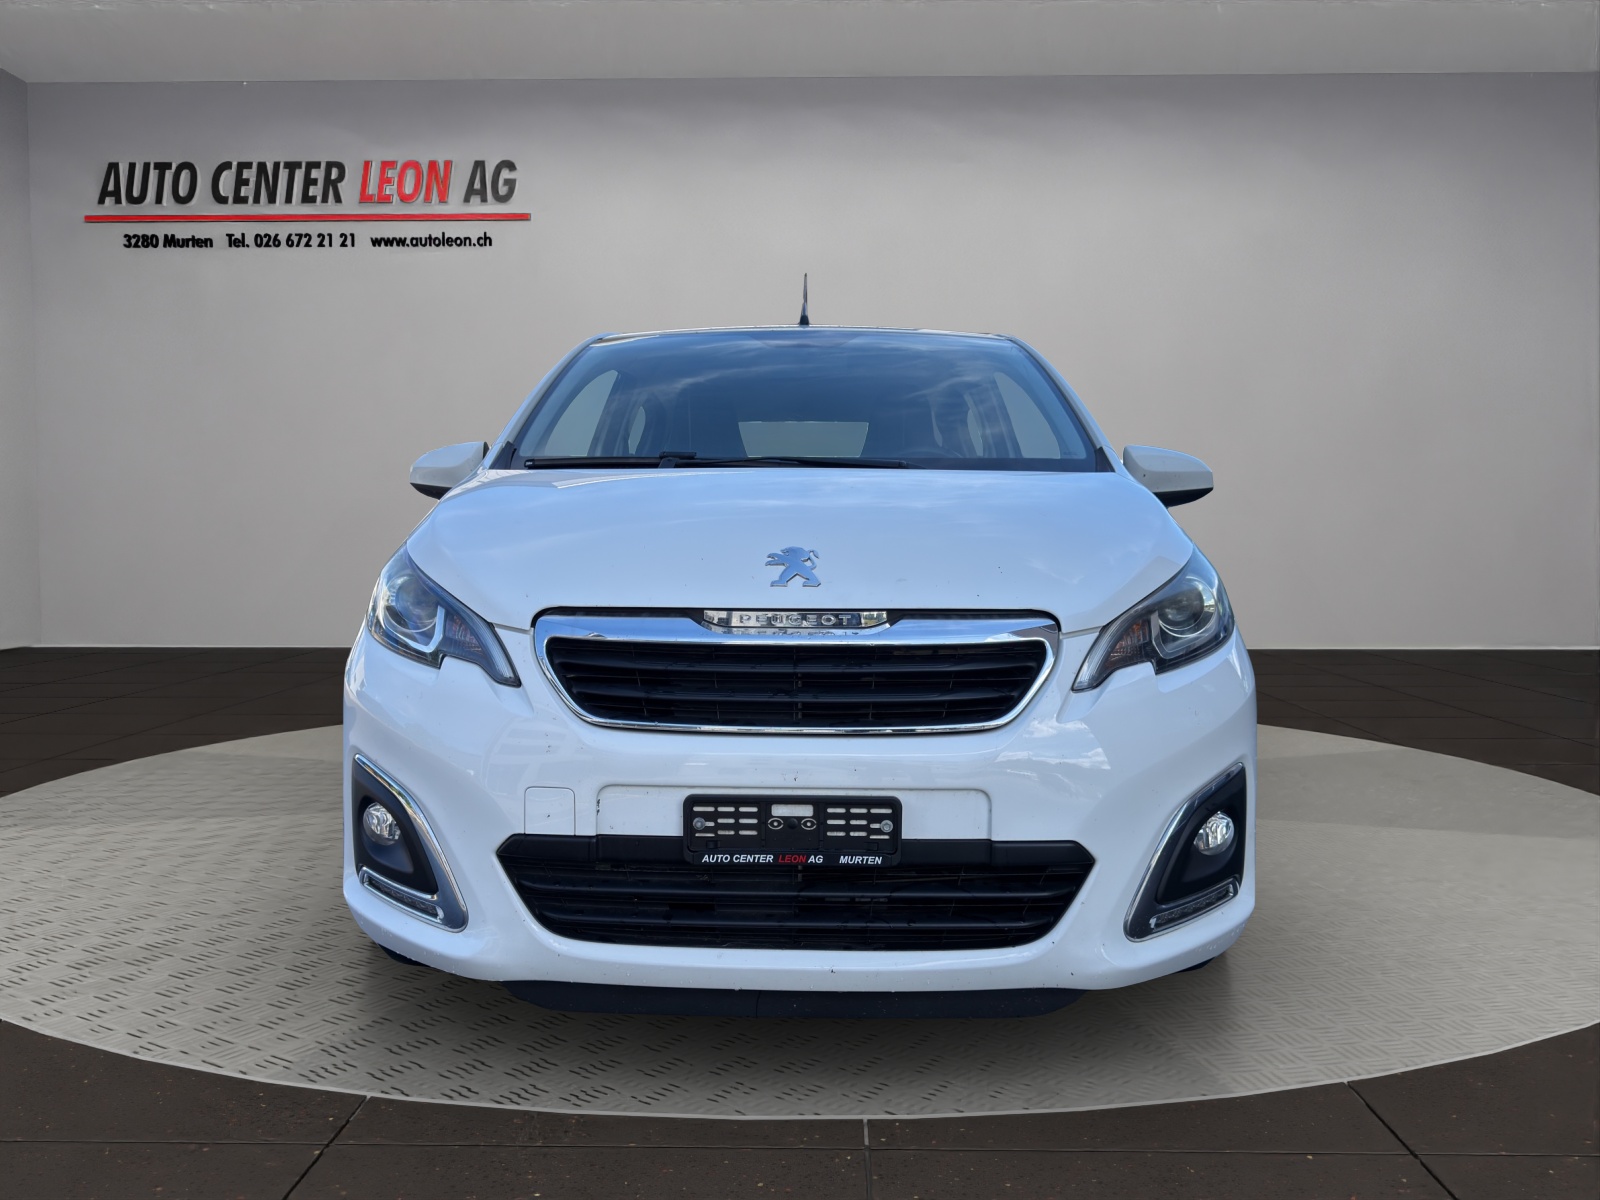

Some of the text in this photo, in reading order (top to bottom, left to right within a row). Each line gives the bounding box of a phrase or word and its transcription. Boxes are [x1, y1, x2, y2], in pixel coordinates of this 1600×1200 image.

[98, 158, 518, 206] AUTO CENTER LEON AG
[123, 231, 493, 249] 3280 Murten Tel. 026 672 21 21 www.autoleon.ch
[738, 613, 852, 627] PEUGEOT
[701, 853, 883, 866] AUTO CENTER LEON AG MURTEN
